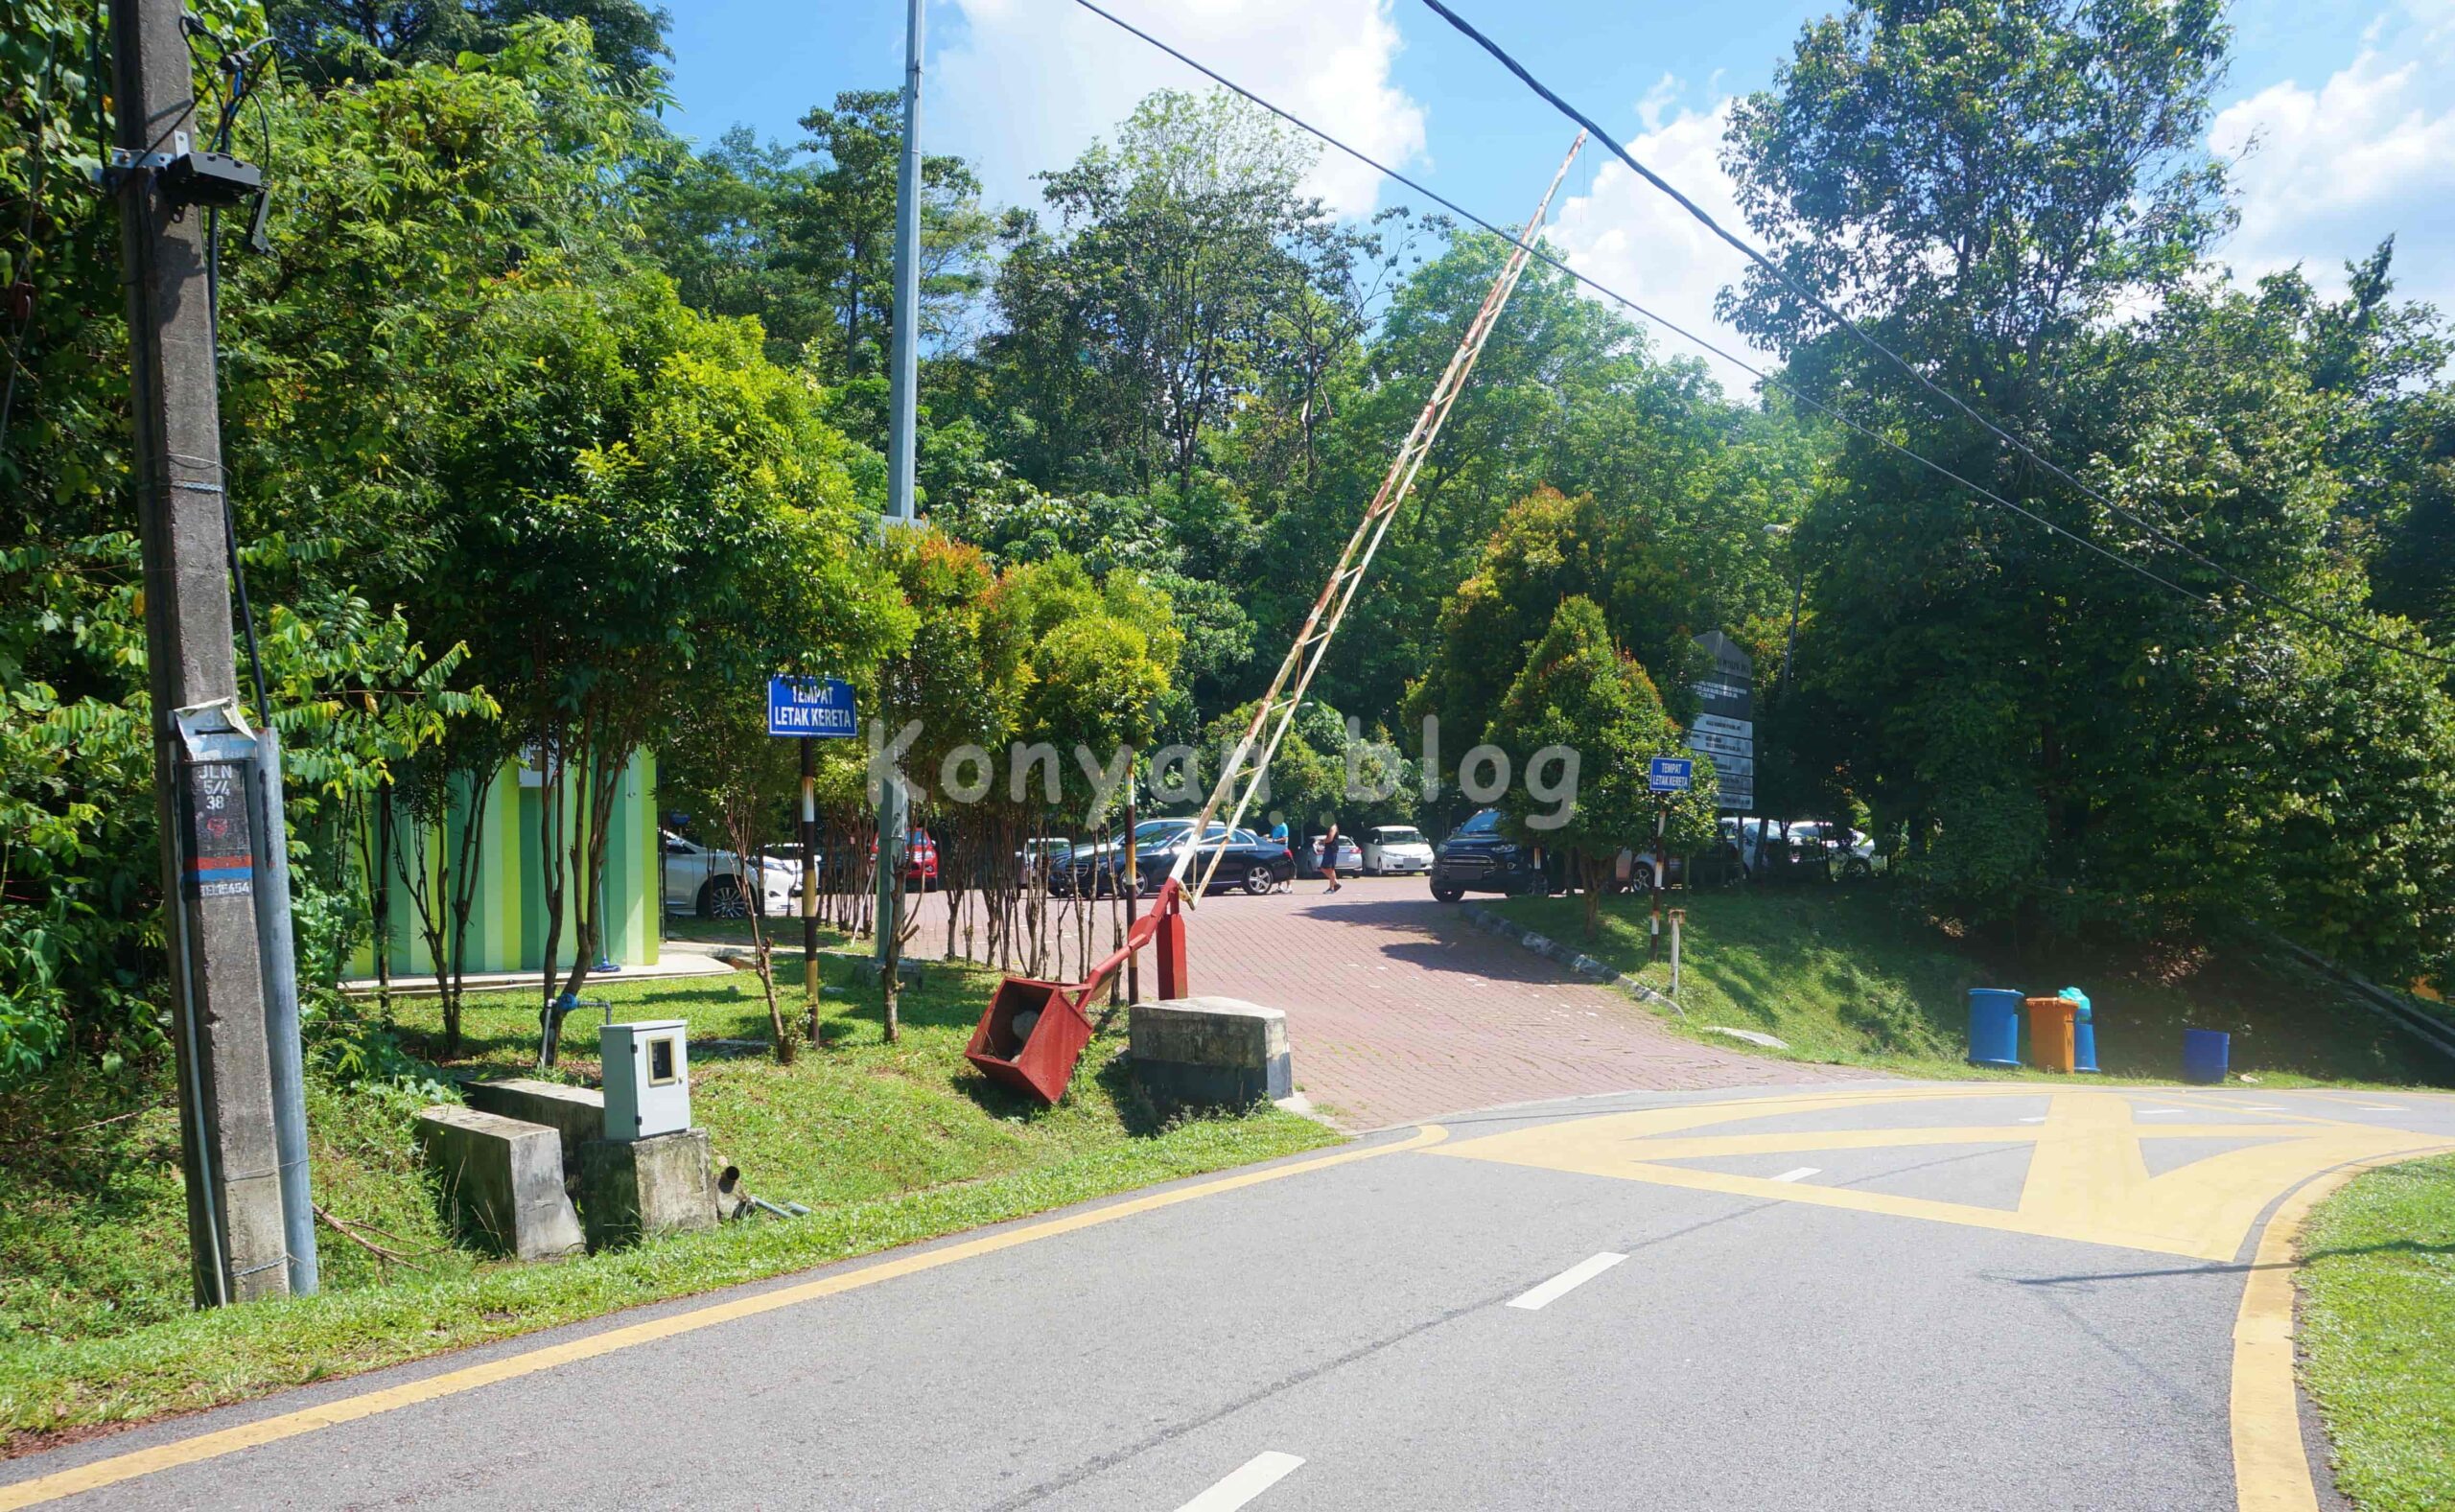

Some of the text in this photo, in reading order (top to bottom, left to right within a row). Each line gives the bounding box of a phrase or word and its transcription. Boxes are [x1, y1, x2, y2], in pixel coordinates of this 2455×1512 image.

[793, 686, 834, 705] TEMPAT
[775, 707, 852, 728] LETAK KERETA
[199, 764, 232, 779] JLN
[1661, 762, 1682, 774] TEMPAT
[1652, 775, 1688, 787] LETAK KERETA
[206, 795, 224, 810] 38
